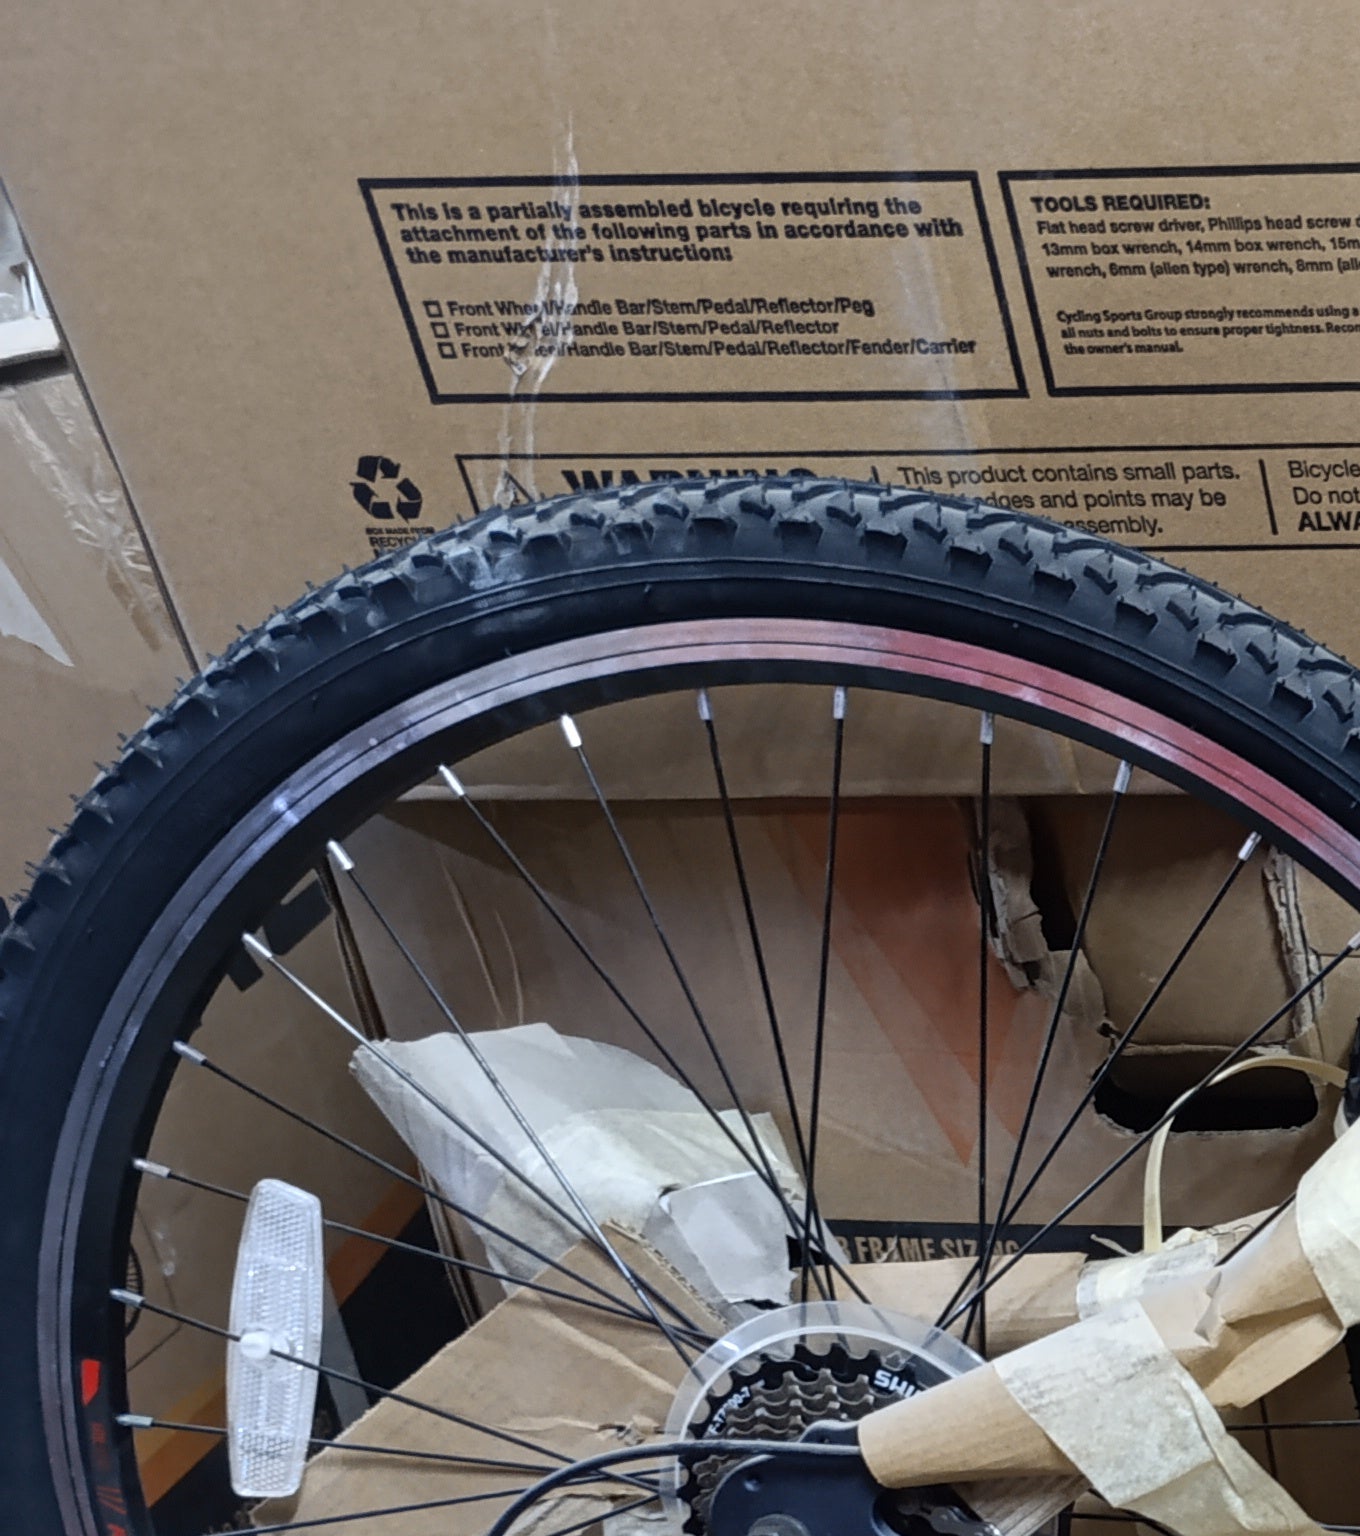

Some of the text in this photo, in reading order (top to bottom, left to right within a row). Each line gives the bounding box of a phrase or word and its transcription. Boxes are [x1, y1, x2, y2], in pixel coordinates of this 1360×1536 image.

[390, 197, 922, 222] This is a partially assembled bicycle requiring the
[1030, 194, 1210, 213] TOOLS REQUIRED:
[400, 218, 964, 244] attachment of the following parts in accordance with
[1036, 221, 1066, 235] Flat
[1068, 220, 1106, 233] head
[1110, 222, 1154, 233] screw
[1158, 219, 1205, 233] driver,
[1208, 217, 1262, 233] Phillips
[1264, 215, 1302, 230] head
[1306, 217, 1351, 229] screw
[406, 244, 733, 264] the manufacturer's instruction:
[1041, 243, 1088, 256] 13mm
[1091, 242, 1119, 255] box
[1122, 241, 1182, 255] wrench,
[1186, 240, 1231, 253] 14mm
[1234, 239, 1263, 252] box
[1266, 237, 1326, 251] wrench,
[1046, 263, 1106, 279] wrench,
[1109, 262, 1146, 276] 6mm
[1150, 262, 1190, 278] (allen
[1192, 260, 1230, 277] type)
[1233, 259, 1293, 275] wrench,
[1295, 259, 1333, 272] 8mm
[446, 297, 875, 317] Front Bar/Stem/Pedal/Reflector/Peg
[1056, 310, 1101, 325] Cycling
[1102, 310, 1142, 323] Sports
[1144, 309, 1182, 322] Group
[1184, 308, 1233, 321] strongly
[1236, 306, 1314, 318] recommends
[1316, 305, 1350, 319] using
[897, 462, 1240, 489] This product contains small parts.
[1288, 459, 1360, 482] Bicycle
[1040, 490, 1078, 508] and
[1083, 490, 1146, 511] points
[1151, 493, 1194, 510] may
[1199, 488, 1226, 506] be
[1293, 486, 1322, 505] Do
